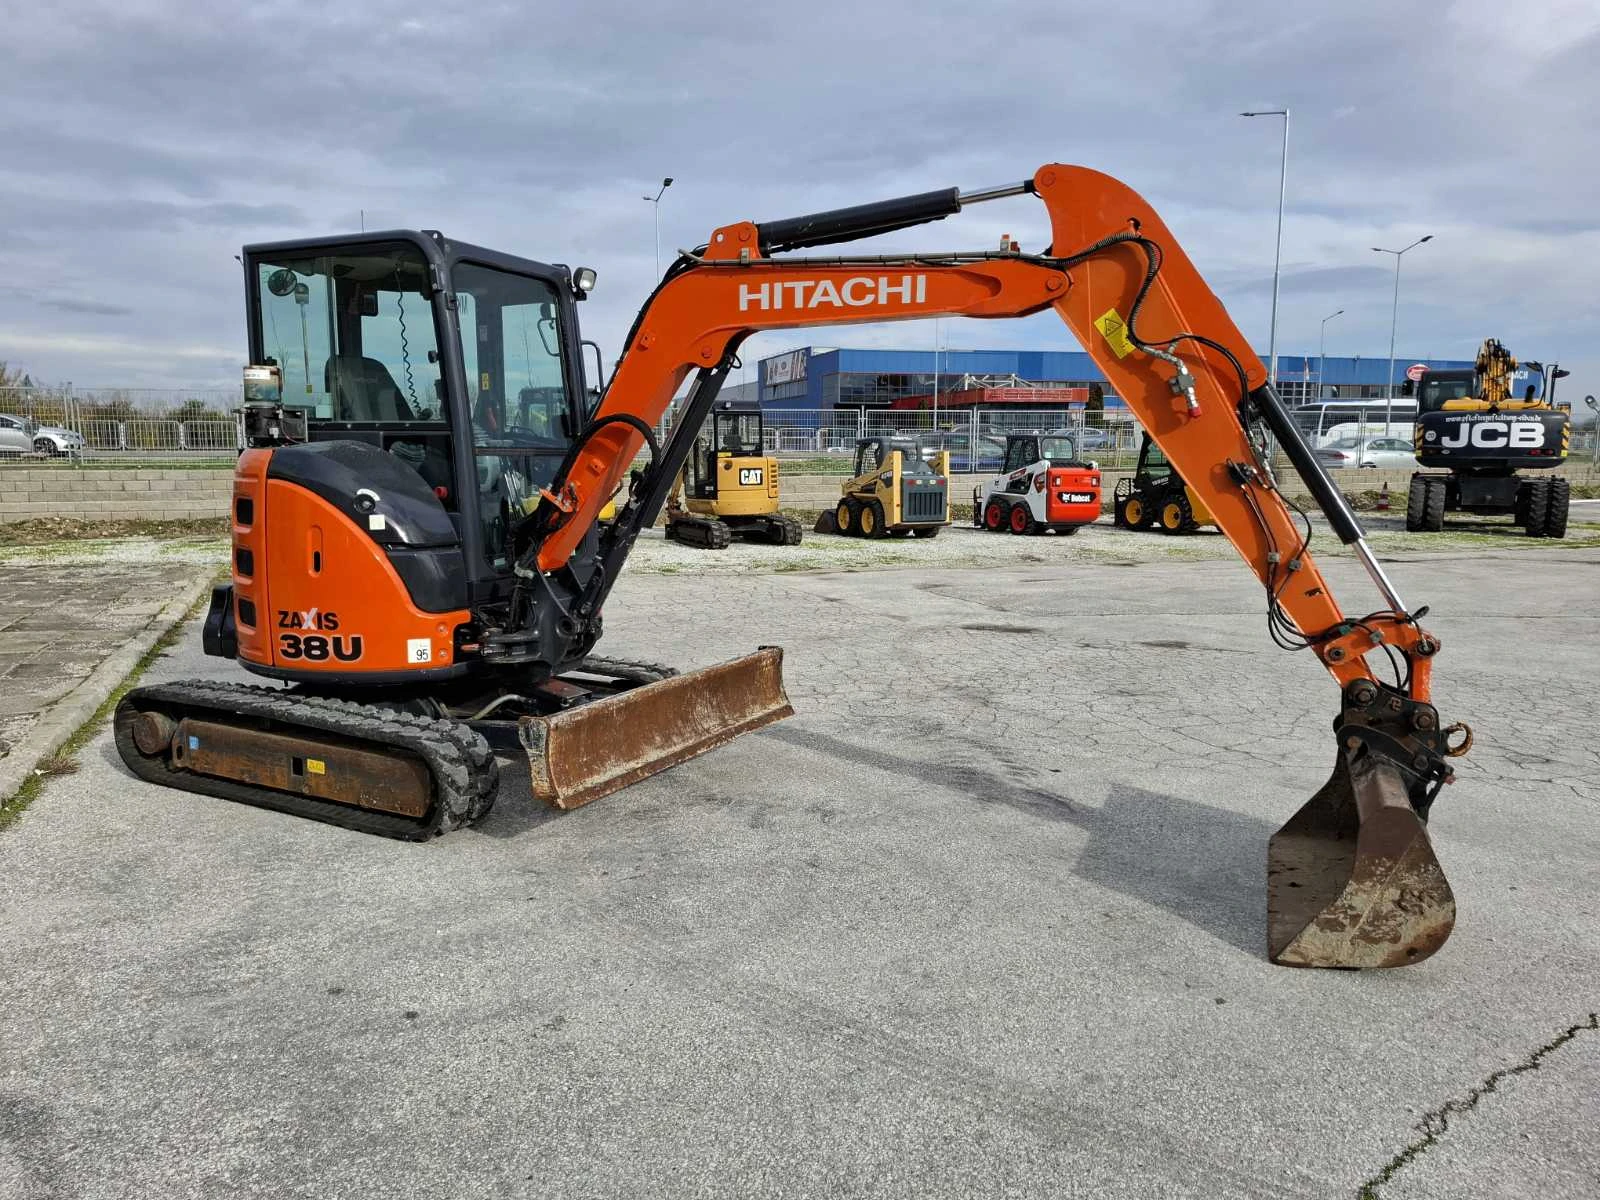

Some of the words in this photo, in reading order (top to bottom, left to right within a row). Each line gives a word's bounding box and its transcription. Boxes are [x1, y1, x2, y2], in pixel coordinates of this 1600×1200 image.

[739, 275, 926, 311] HITACHI
[1441, 422, 1545, 448] JCB
[741, 469, 762, 485] CAT
[278, 607, 339, 630] ZAXIS
[279, 633, 363, 662] 38U
[416, 649, 429, 661] 95
